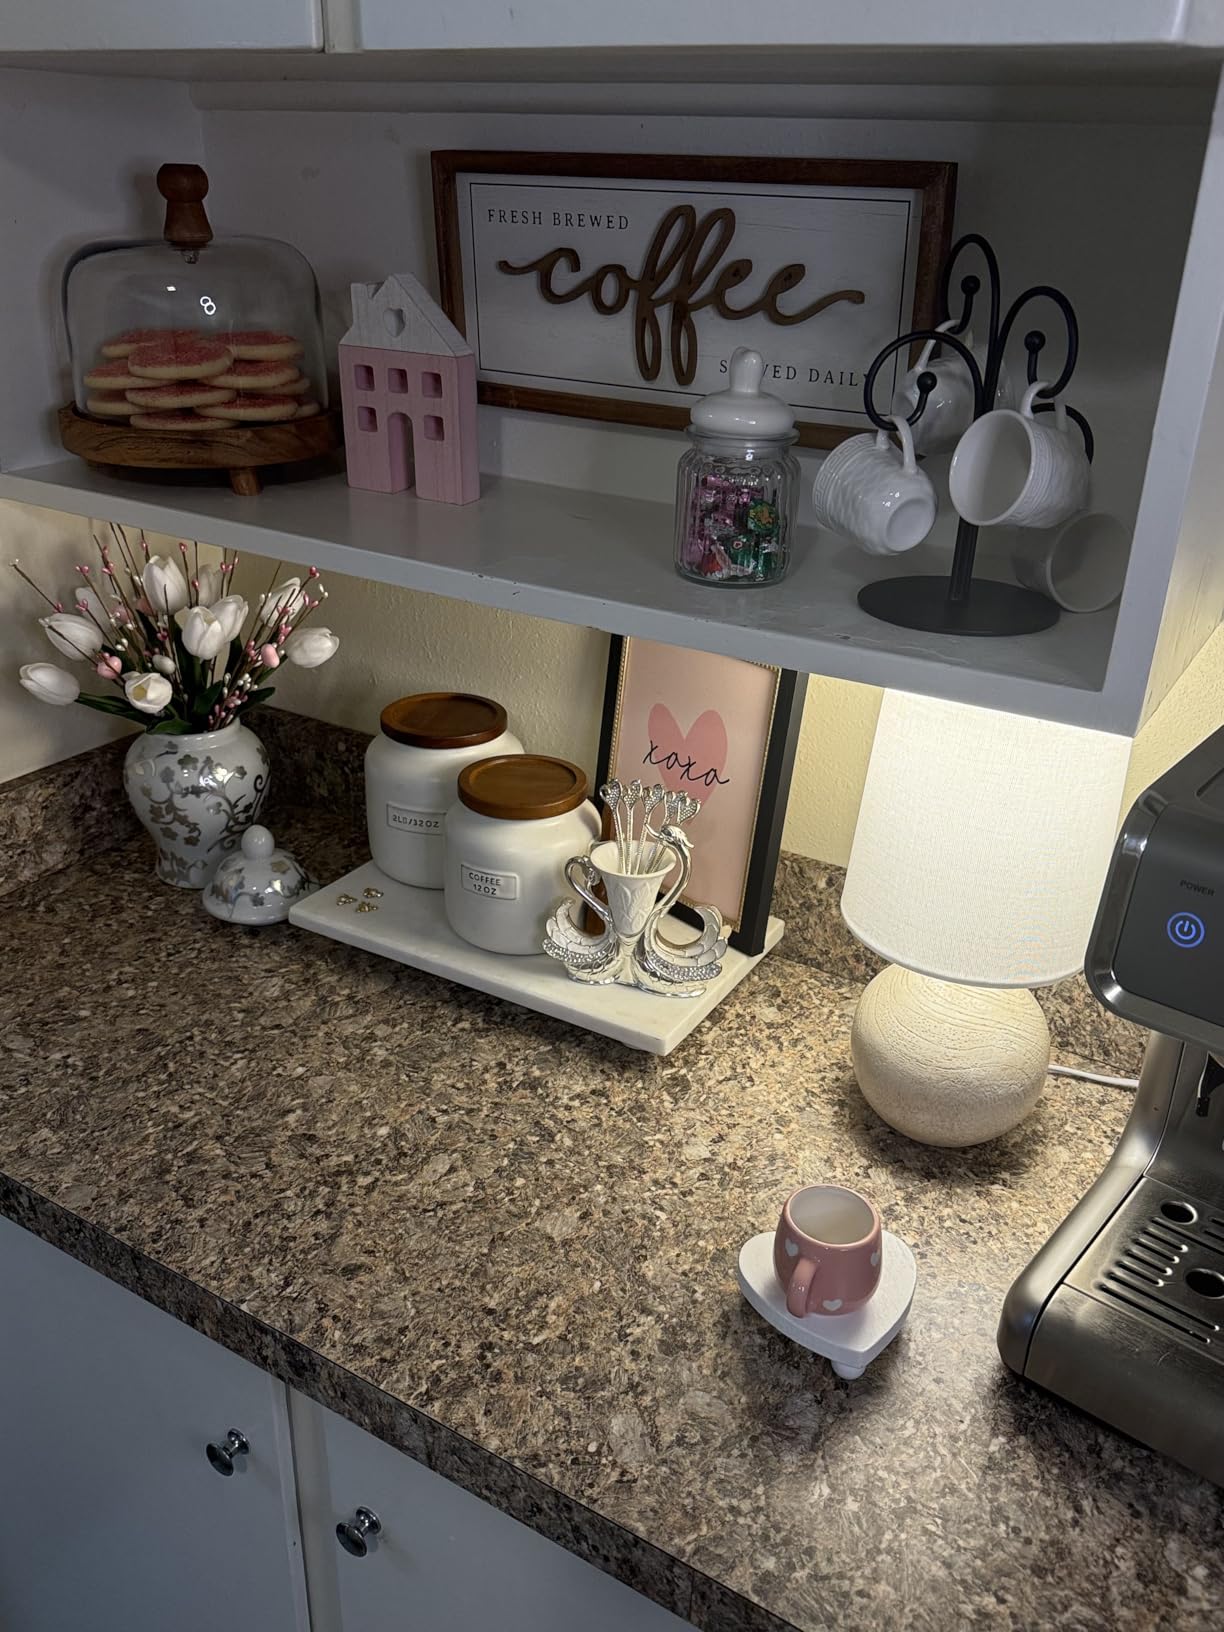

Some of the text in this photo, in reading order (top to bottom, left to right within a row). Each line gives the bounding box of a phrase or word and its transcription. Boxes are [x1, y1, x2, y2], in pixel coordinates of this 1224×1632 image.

[487, 208, 629, 230] FRESH BREWED
[498, 204, 865, 386] coffee
[808, 368, 870, 387] DAIL
[468, 871, 502, 887] COFFEE
[1179, 879, 1215, 897] POWER
